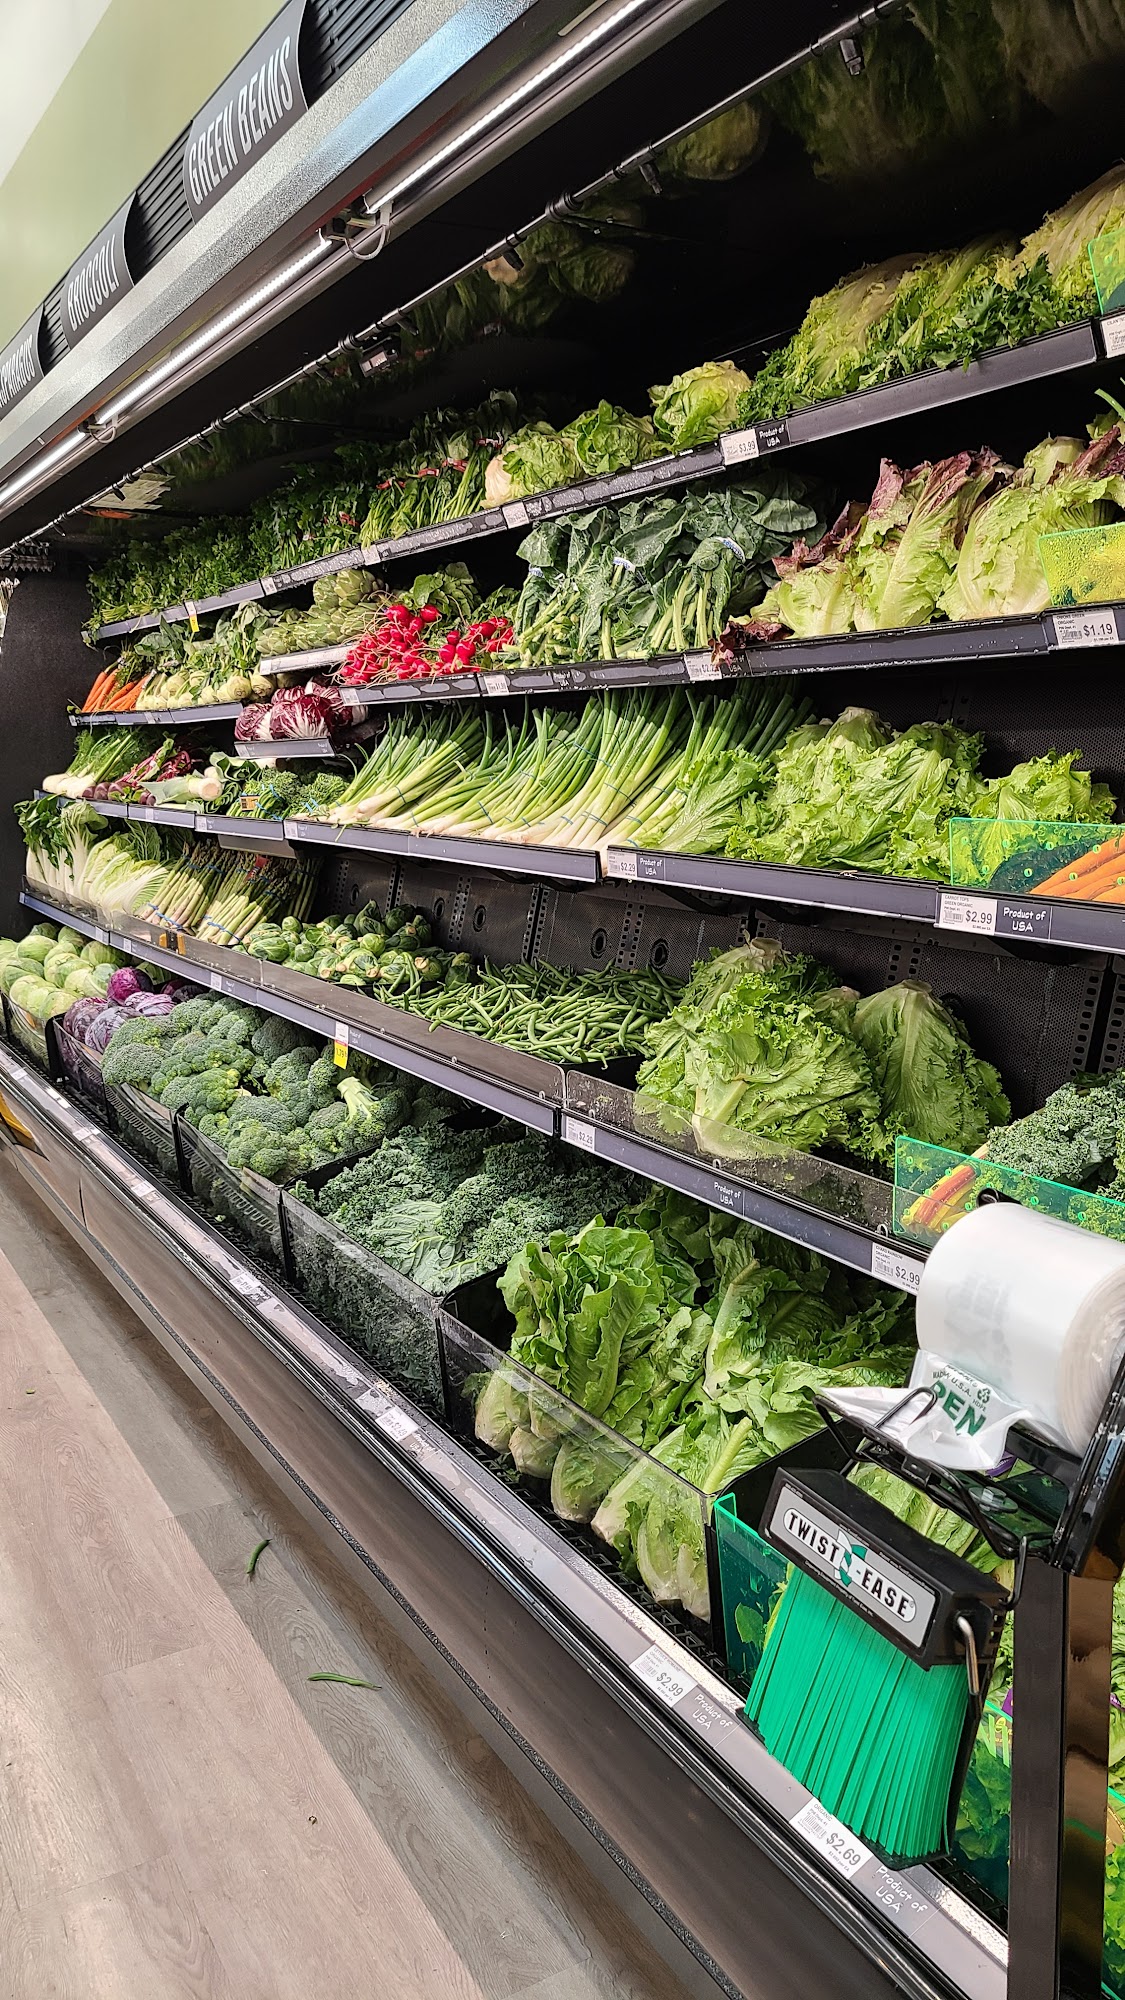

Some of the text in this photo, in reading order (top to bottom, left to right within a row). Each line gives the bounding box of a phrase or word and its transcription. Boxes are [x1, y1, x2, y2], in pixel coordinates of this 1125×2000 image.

[188, 35, 293, 206] GREEN BEANS
[67, 233, 120, 332] BROCCOLI
[759, 423, 785, 439] Product of
[738, 440, 756, 454] $3.99
[766, 436, 781, 447] USA
[1083, 623, 1113, 637] $1.19
[639, 857, 656, 867] Product
[645, 867, 657, 876] USA
[965, 910, 993, 925] $2.99
[1003, 906, 1047, 921] Product of
[1012, 921, 1034, 932] USA
[578, 1131, 593, 1145] $2.29
[714, 1181, 742, 1199] Product of
[720, 1193, 734, 1207] USA
[895, 1265, 921, 1286] $2.99
[951, 1377, 972, 1397] U.S.A.
[788, 1511, 840, 1564] TWIST
[656, 1672, 684, 1697] $2.99
[692, 1709, 712, 1730] USA
[694, 1694, 733, 1728] Product of
[813, 1803, 832, 1822] ORGANIC
[826, 1832, 862, 1866] $2.69
[876, 1865, 928, 1913] Product of
[875, 1886, 901, 1914] USA
